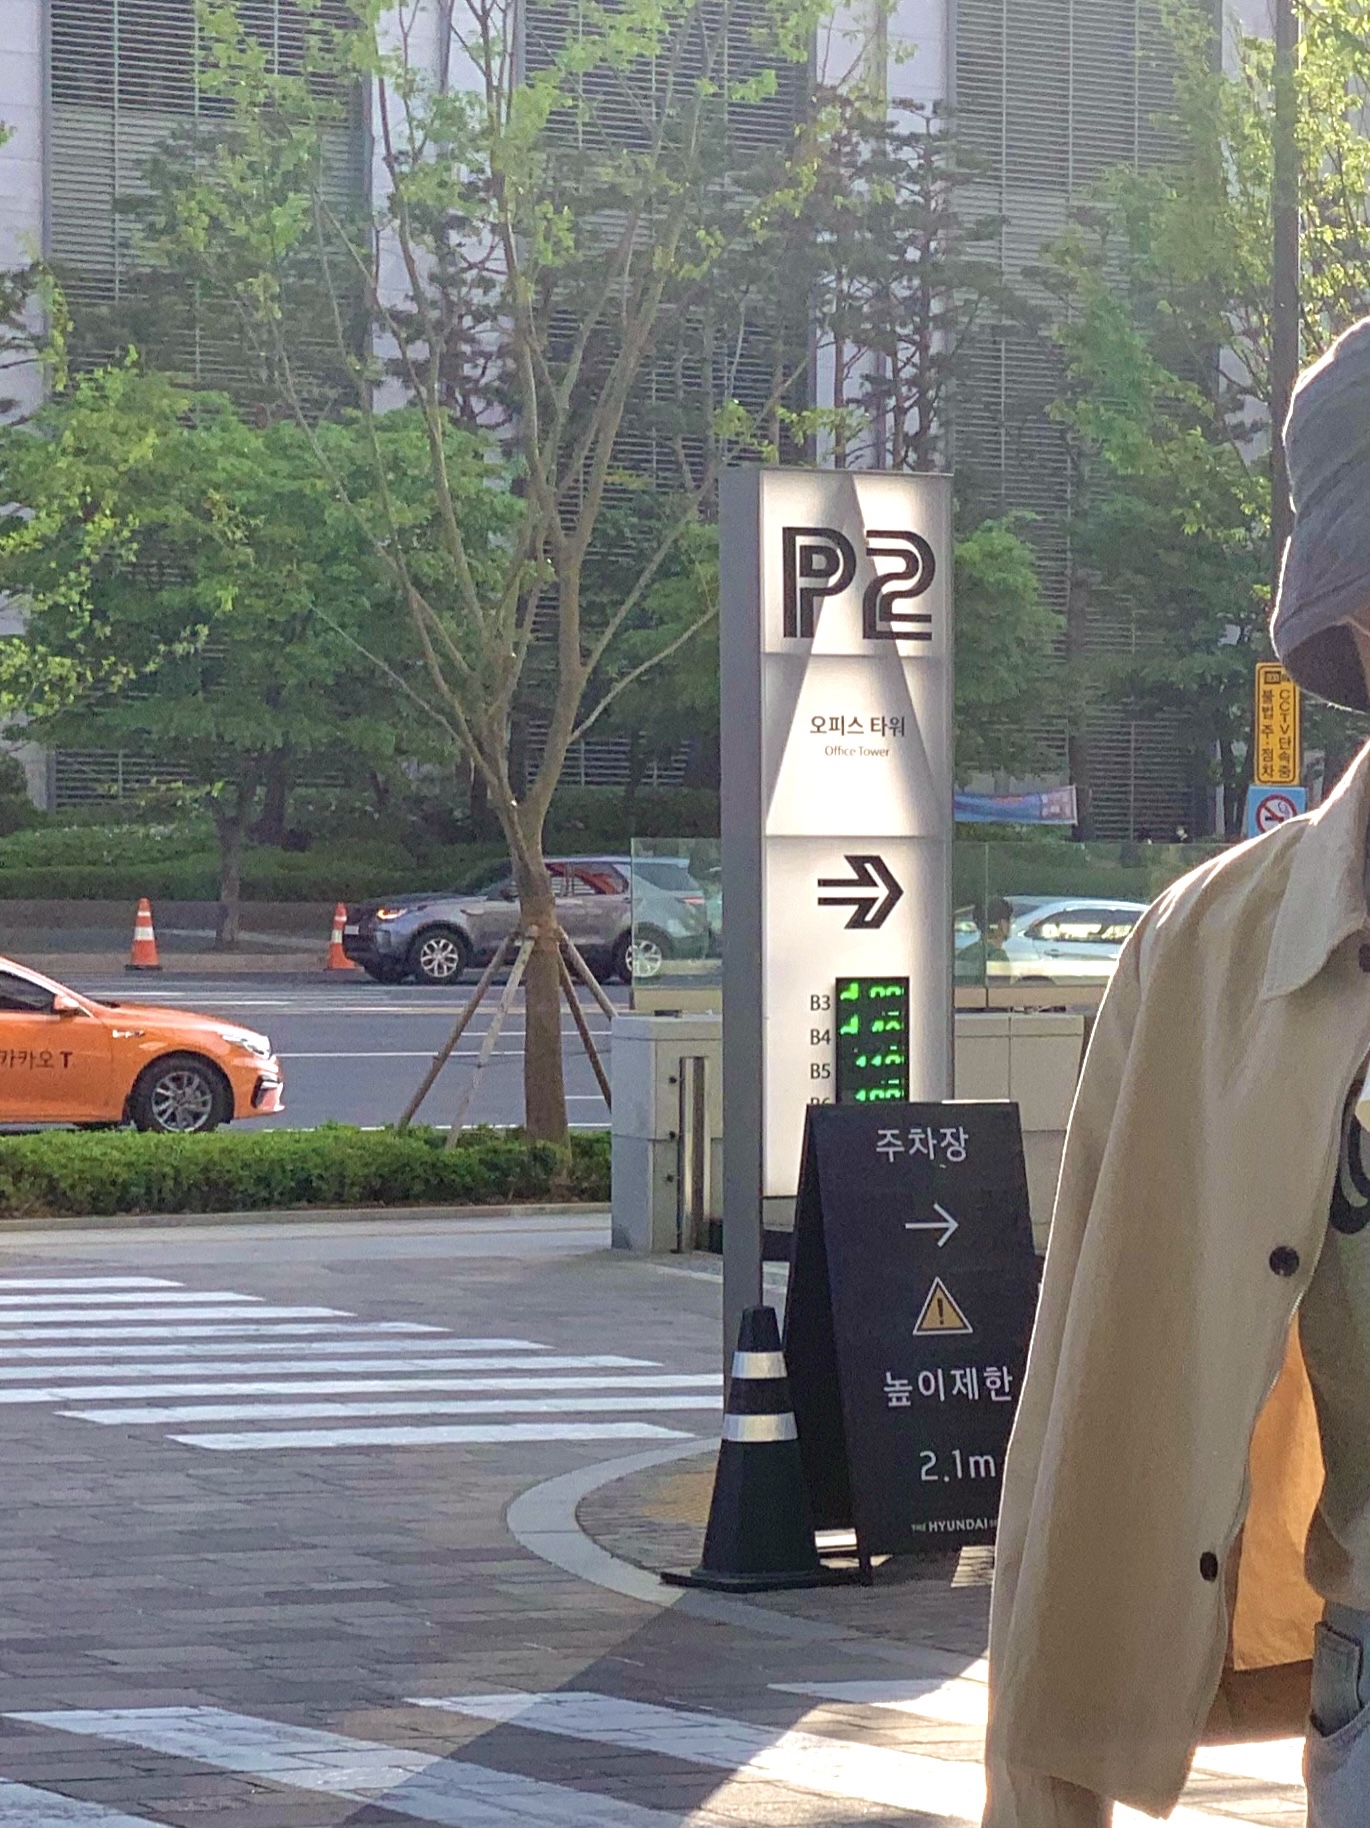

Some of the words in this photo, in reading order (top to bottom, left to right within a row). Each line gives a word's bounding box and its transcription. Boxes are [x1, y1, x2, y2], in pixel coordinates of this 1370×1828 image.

[782, 526, 936, 640] P2
[810, 715, 864, 736] 오피스
[870, 716, 905, 737] 타워
[824, 745, 856, 757] Office
[858, 745, 890, 757] Tower
[810, 994, 831, 1011] B3
[810, 1028, 831, 1046] B4
[0, 1049, 54, 1070] 카카오
[60, 1051, 73, 1068] T
[810, 1063, 831, 1080] B5
[876, 1126, 969, 1163] 주차장
[883, 1366, 1013, 1407] 높이제한
[920, 1449, 996, 1482] 2.1m
[929, 1518, 988, 1532] HYUNDAI
